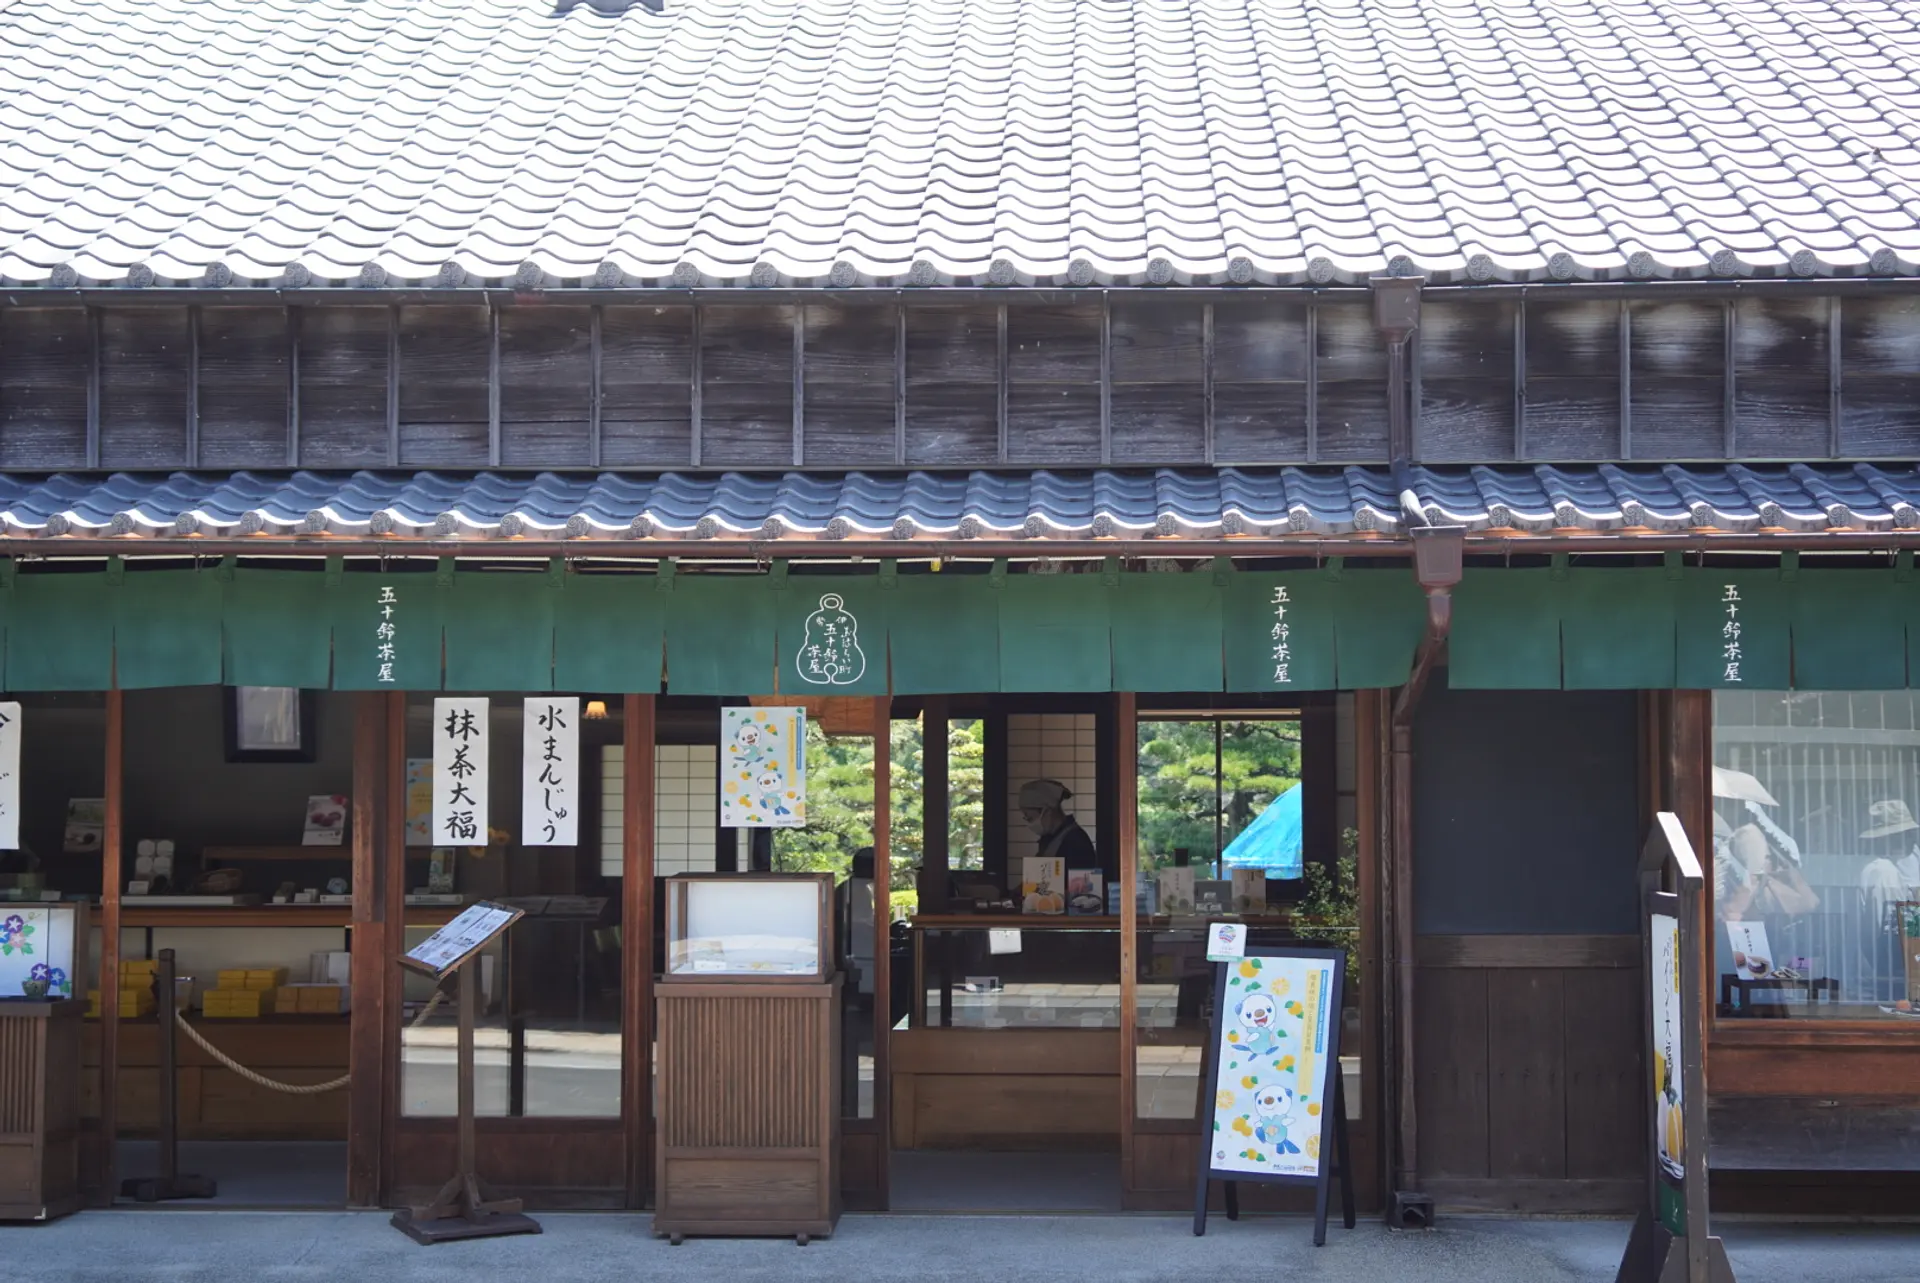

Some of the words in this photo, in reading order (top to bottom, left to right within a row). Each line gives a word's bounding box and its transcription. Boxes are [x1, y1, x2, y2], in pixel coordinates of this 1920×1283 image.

[376, 586, 398, 682] 五十鈴茶屋
[1270, 586, 1292, 683] 五十鈴茶屋
[1720, 584, 1743, 682] 五十鈴茶屋
[444, 708, 480, 840] 抹茶大福
[538, 704, 568, 843] 水まんじゅう
